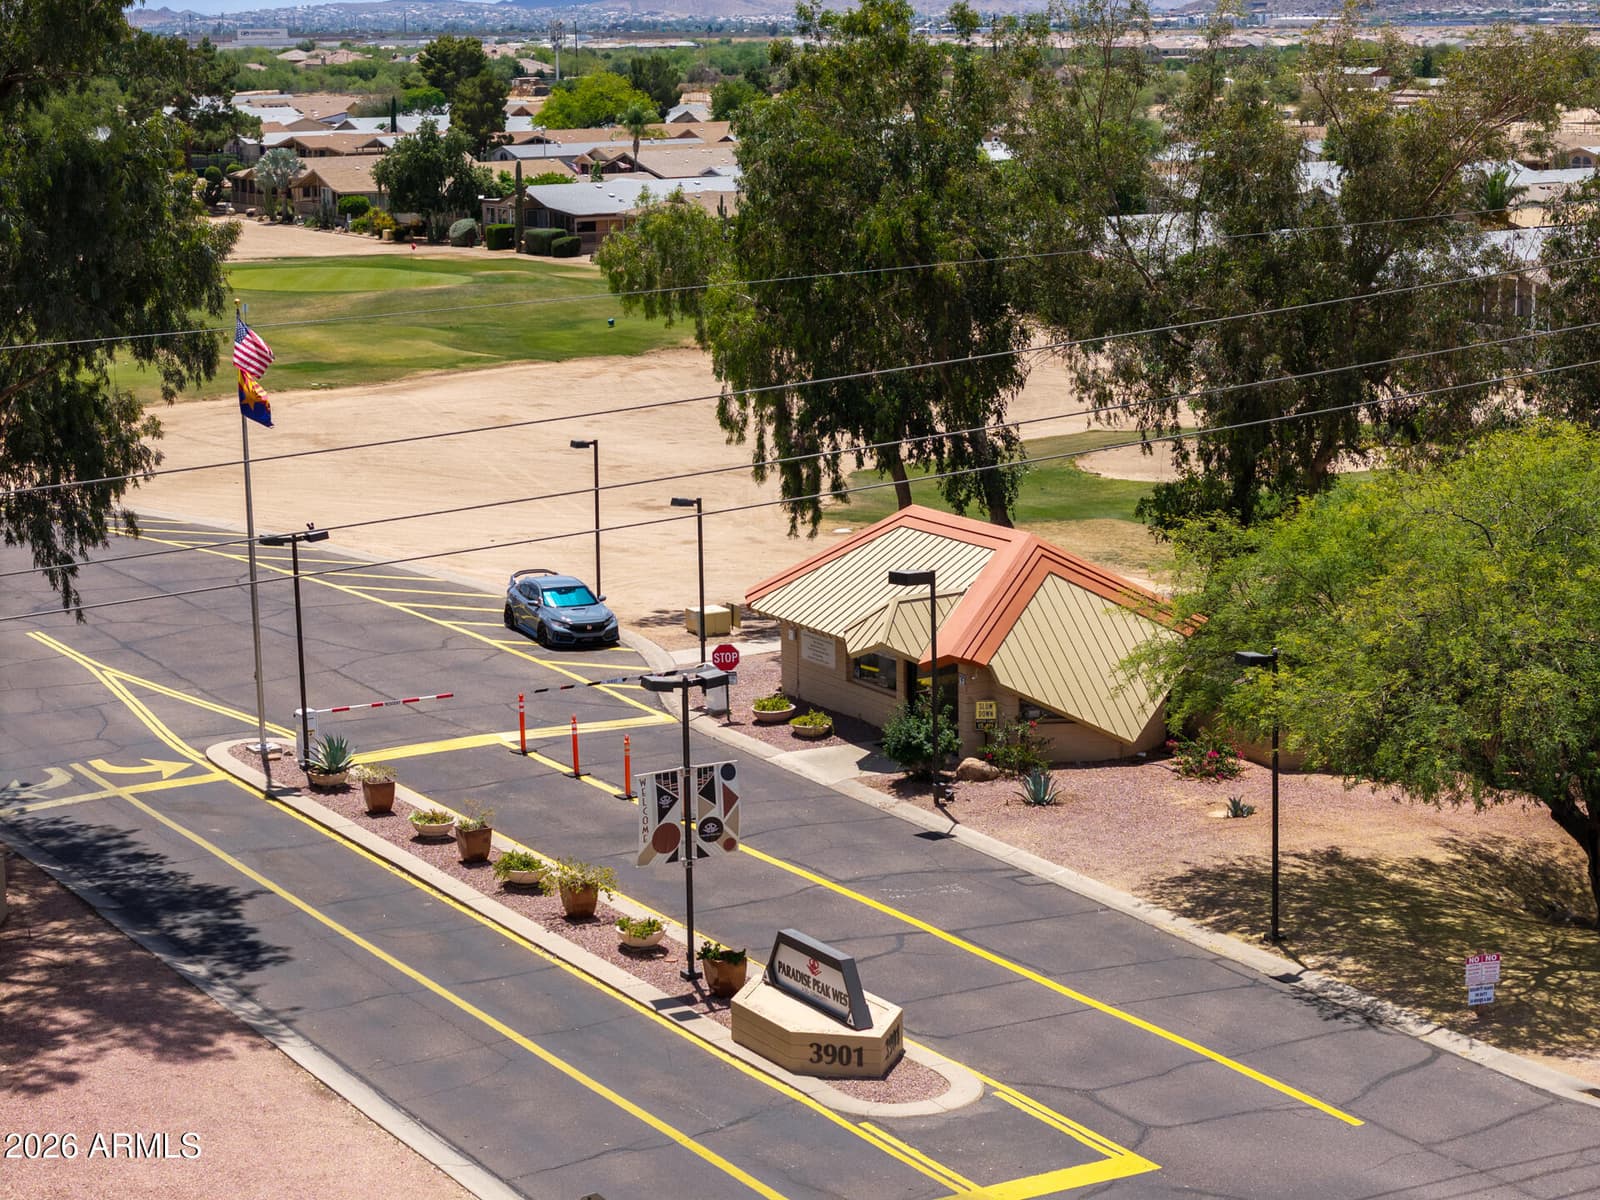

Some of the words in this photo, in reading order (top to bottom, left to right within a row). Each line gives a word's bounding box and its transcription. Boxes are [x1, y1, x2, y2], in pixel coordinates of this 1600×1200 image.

[713, 652, 738, 664] STOP
[639, 778, 650, 843] WELCOME
[777, 960, 812, 989] PARADISE
[812, 977, 831, 1000] PEAK
[831, 987, 849, 1007] WES
[809, 1042, 864, 1068] 3901
